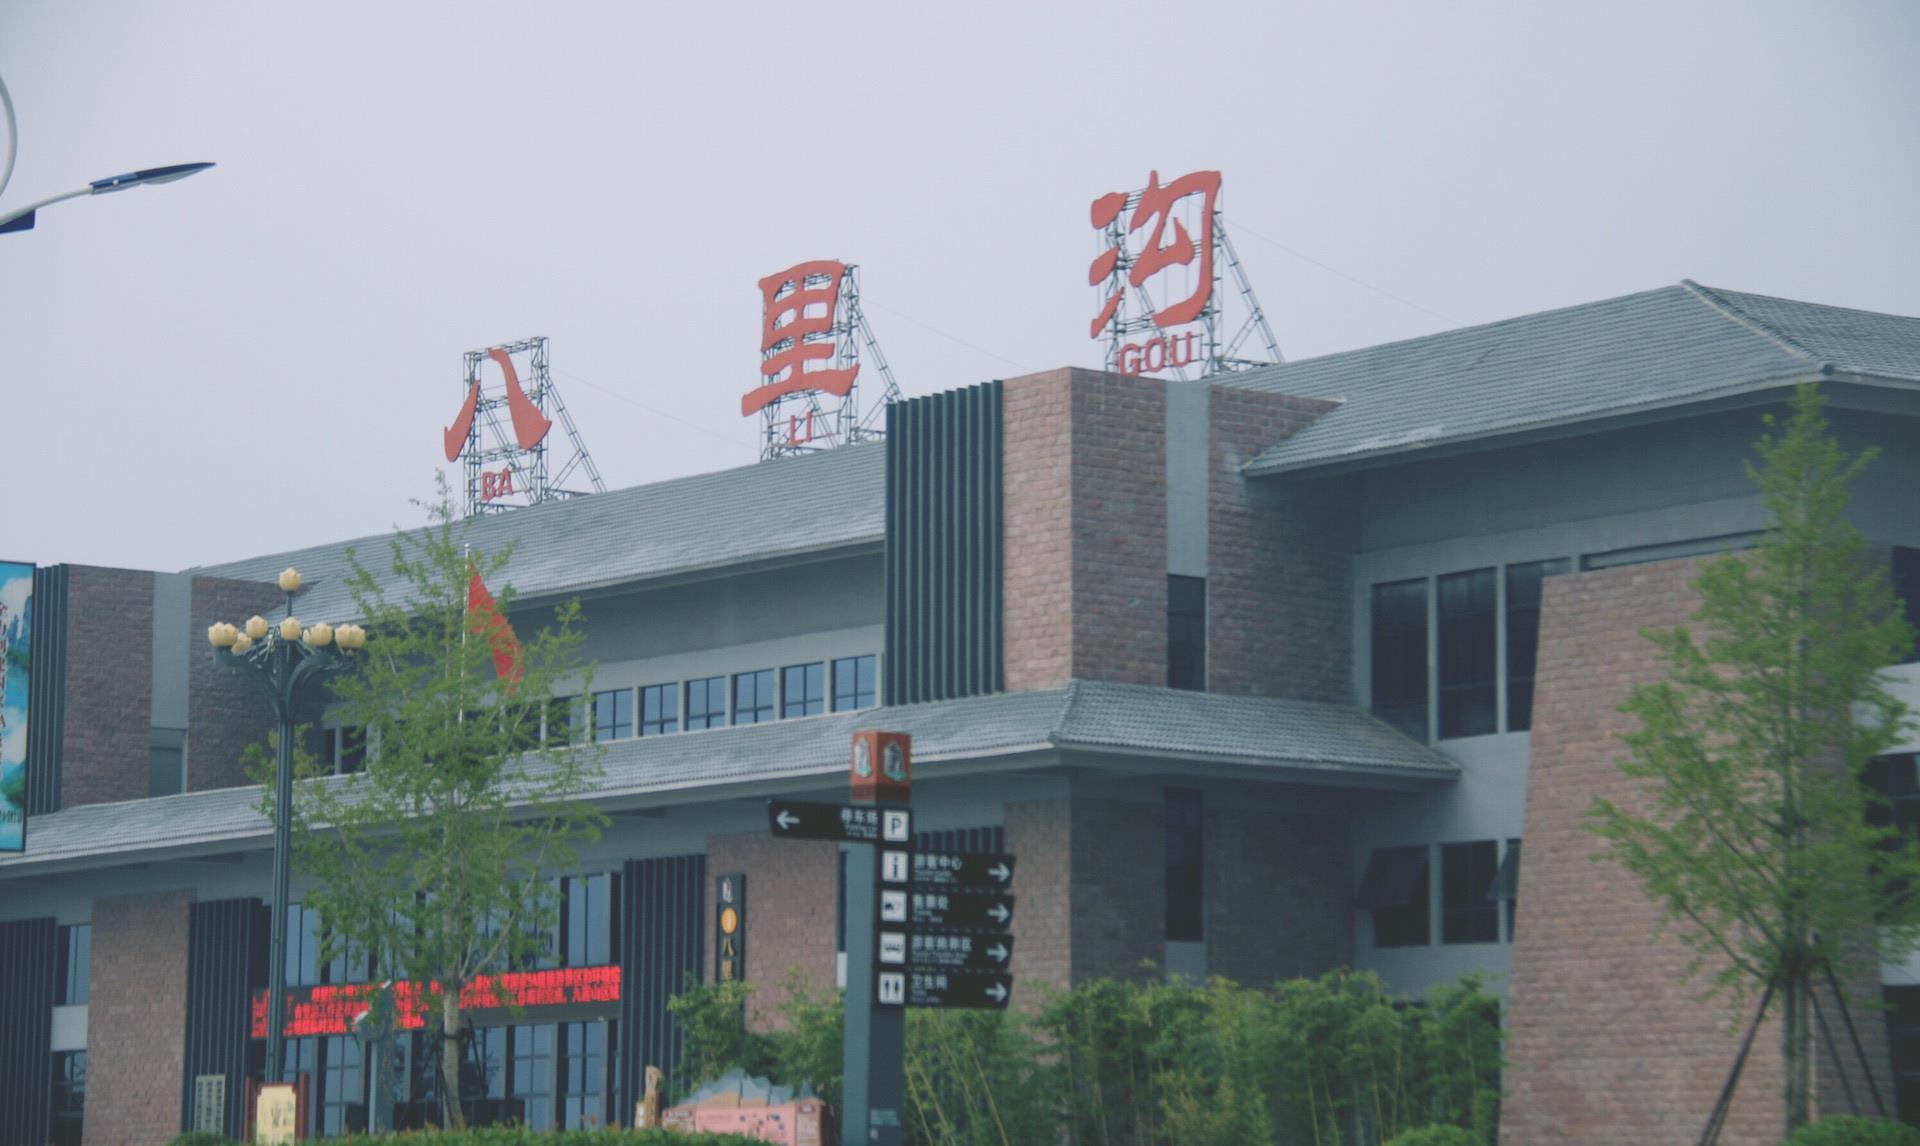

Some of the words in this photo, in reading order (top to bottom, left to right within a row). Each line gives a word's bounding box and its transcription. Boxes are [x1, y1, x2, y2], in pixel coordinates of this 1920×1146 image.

[1089, 170, 1222, 339] 沟
[741, 260, 861, 417] 里
[1119, 332, 1192, 377] GOU
[444, 347, 553, 462] 八
[787, 411, 813, 445] LI
[482, 468, 513, 501] BA
